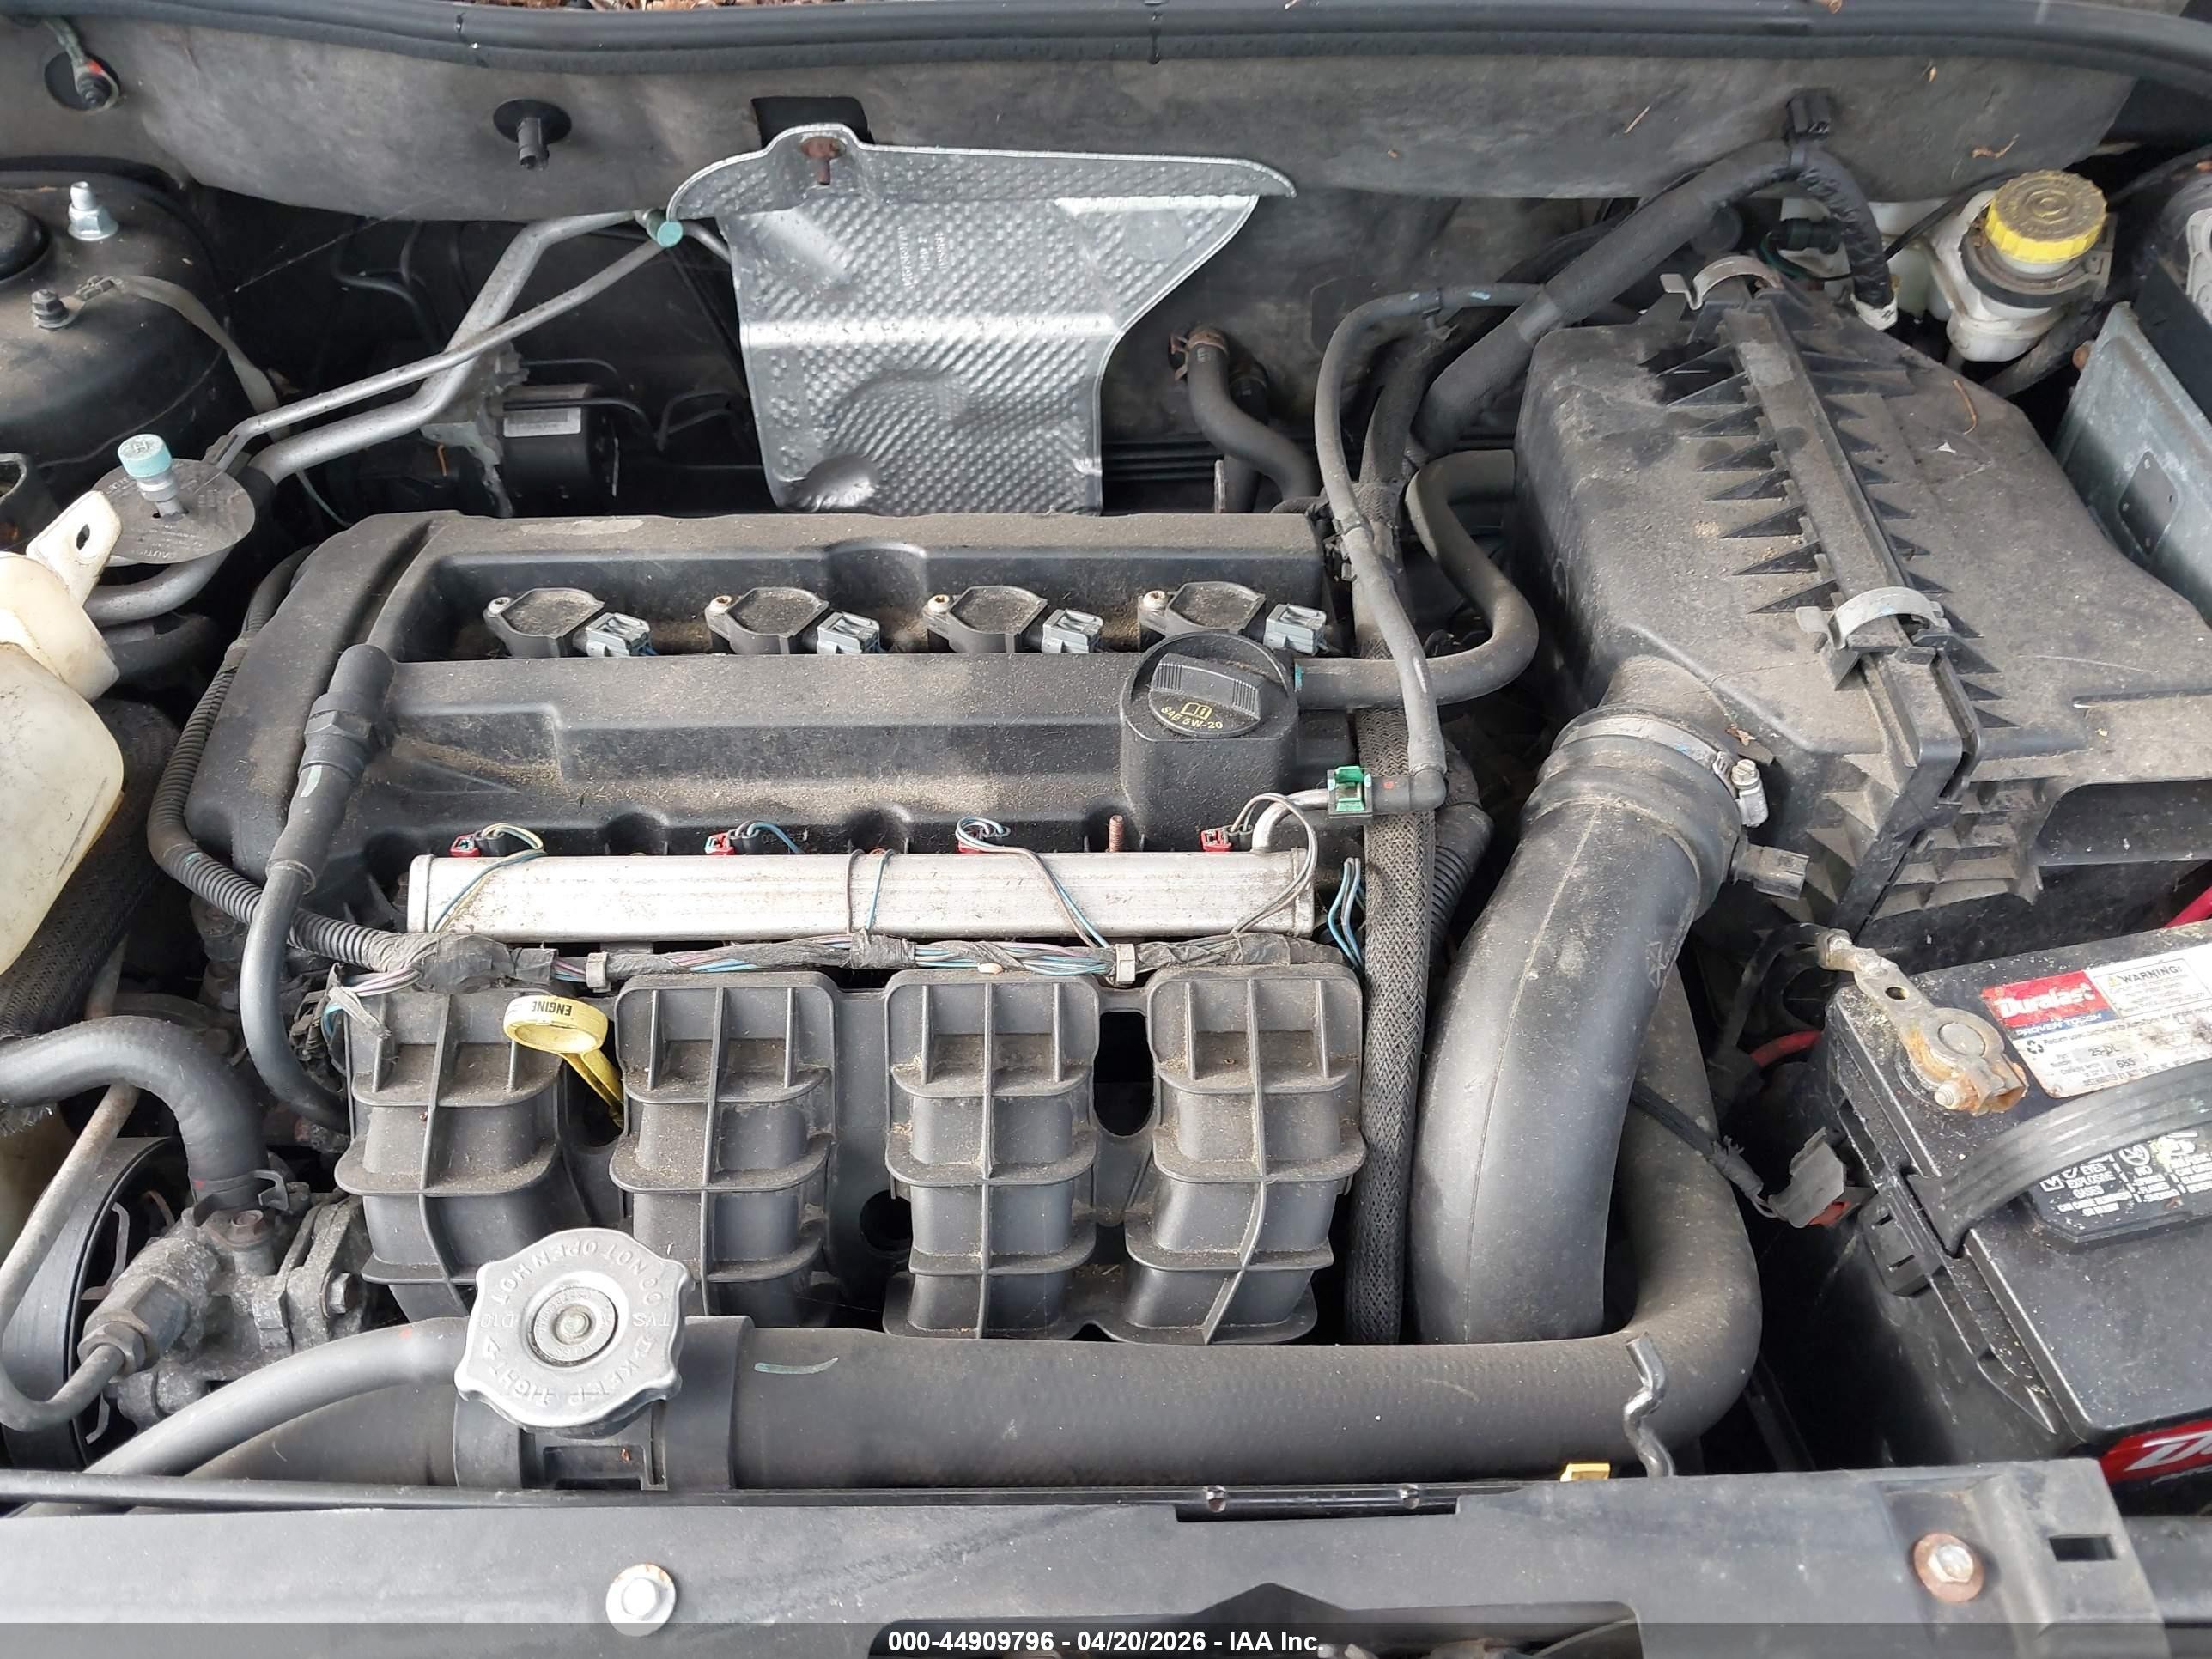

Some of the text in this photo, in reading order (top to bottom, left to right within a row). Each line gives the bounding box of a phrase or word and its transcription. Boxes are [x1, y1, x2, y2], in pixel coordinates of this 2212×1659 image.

[1161, 707, 1182, 720] SAE
[2118, 965, 2183, 983] WARNING:
[1999, 982, 2095, 1018] Duralast
[531, 1000, 573, 1017] ENGINE
[2015, 1020, 2063, 1036] PROVEN
[2088, 1043, 2120, 1056] 25-DL
[2115, 1058, 2136, 1068] 685
[2080, 1163, 2106, 1176] EYES
[2134, 1165, 2153, 1176] NO
[2066, 1171, 2116, 1189] EXPLOSIVE
[2072, 1185, 2105, 1199] GASES
[494, 1239, 664, 1306] DO NOT OPEN HOT
